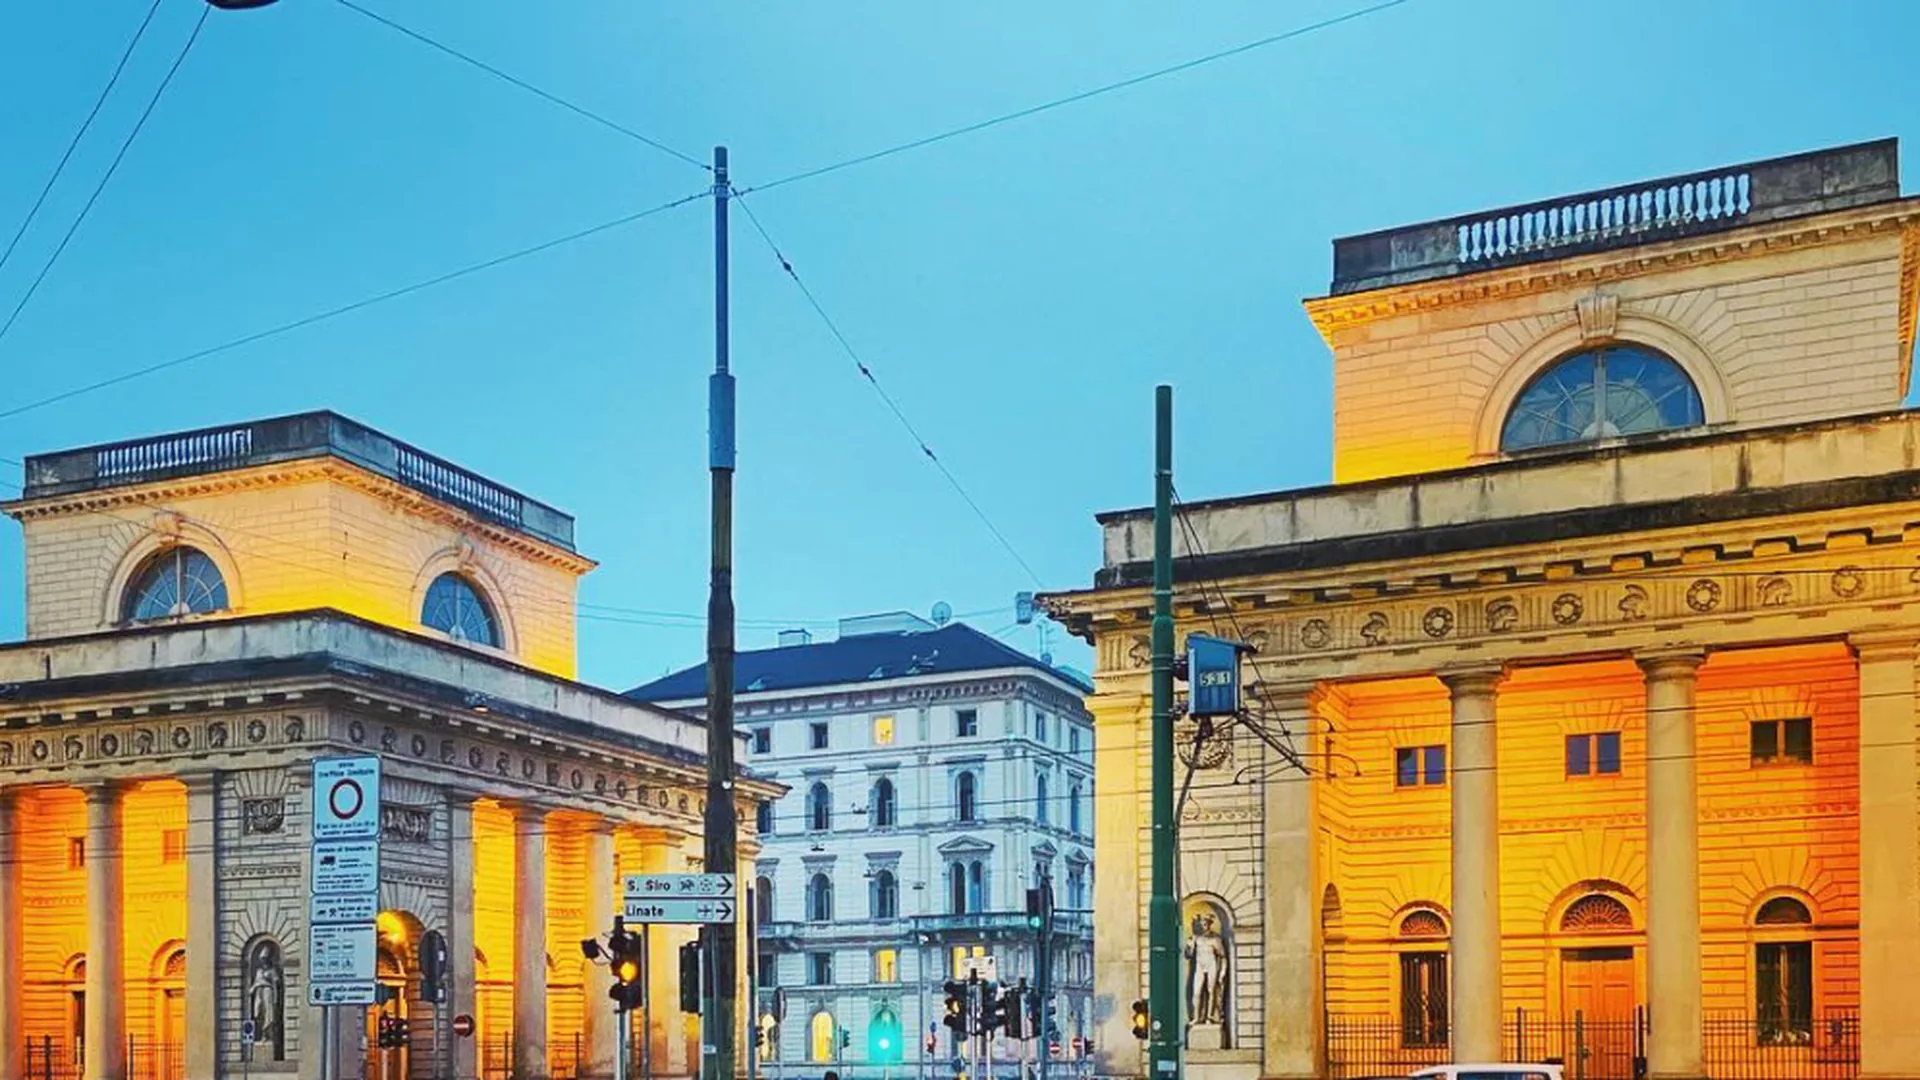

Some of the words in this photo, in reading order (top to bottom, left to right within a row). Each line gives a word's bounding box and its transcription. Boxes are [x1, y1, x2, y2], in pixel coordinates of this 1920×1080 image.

[627, 880, 640, 892] S.
[646, 879, 671, 892] Siro
[626, 904, 665, 917] Linate
